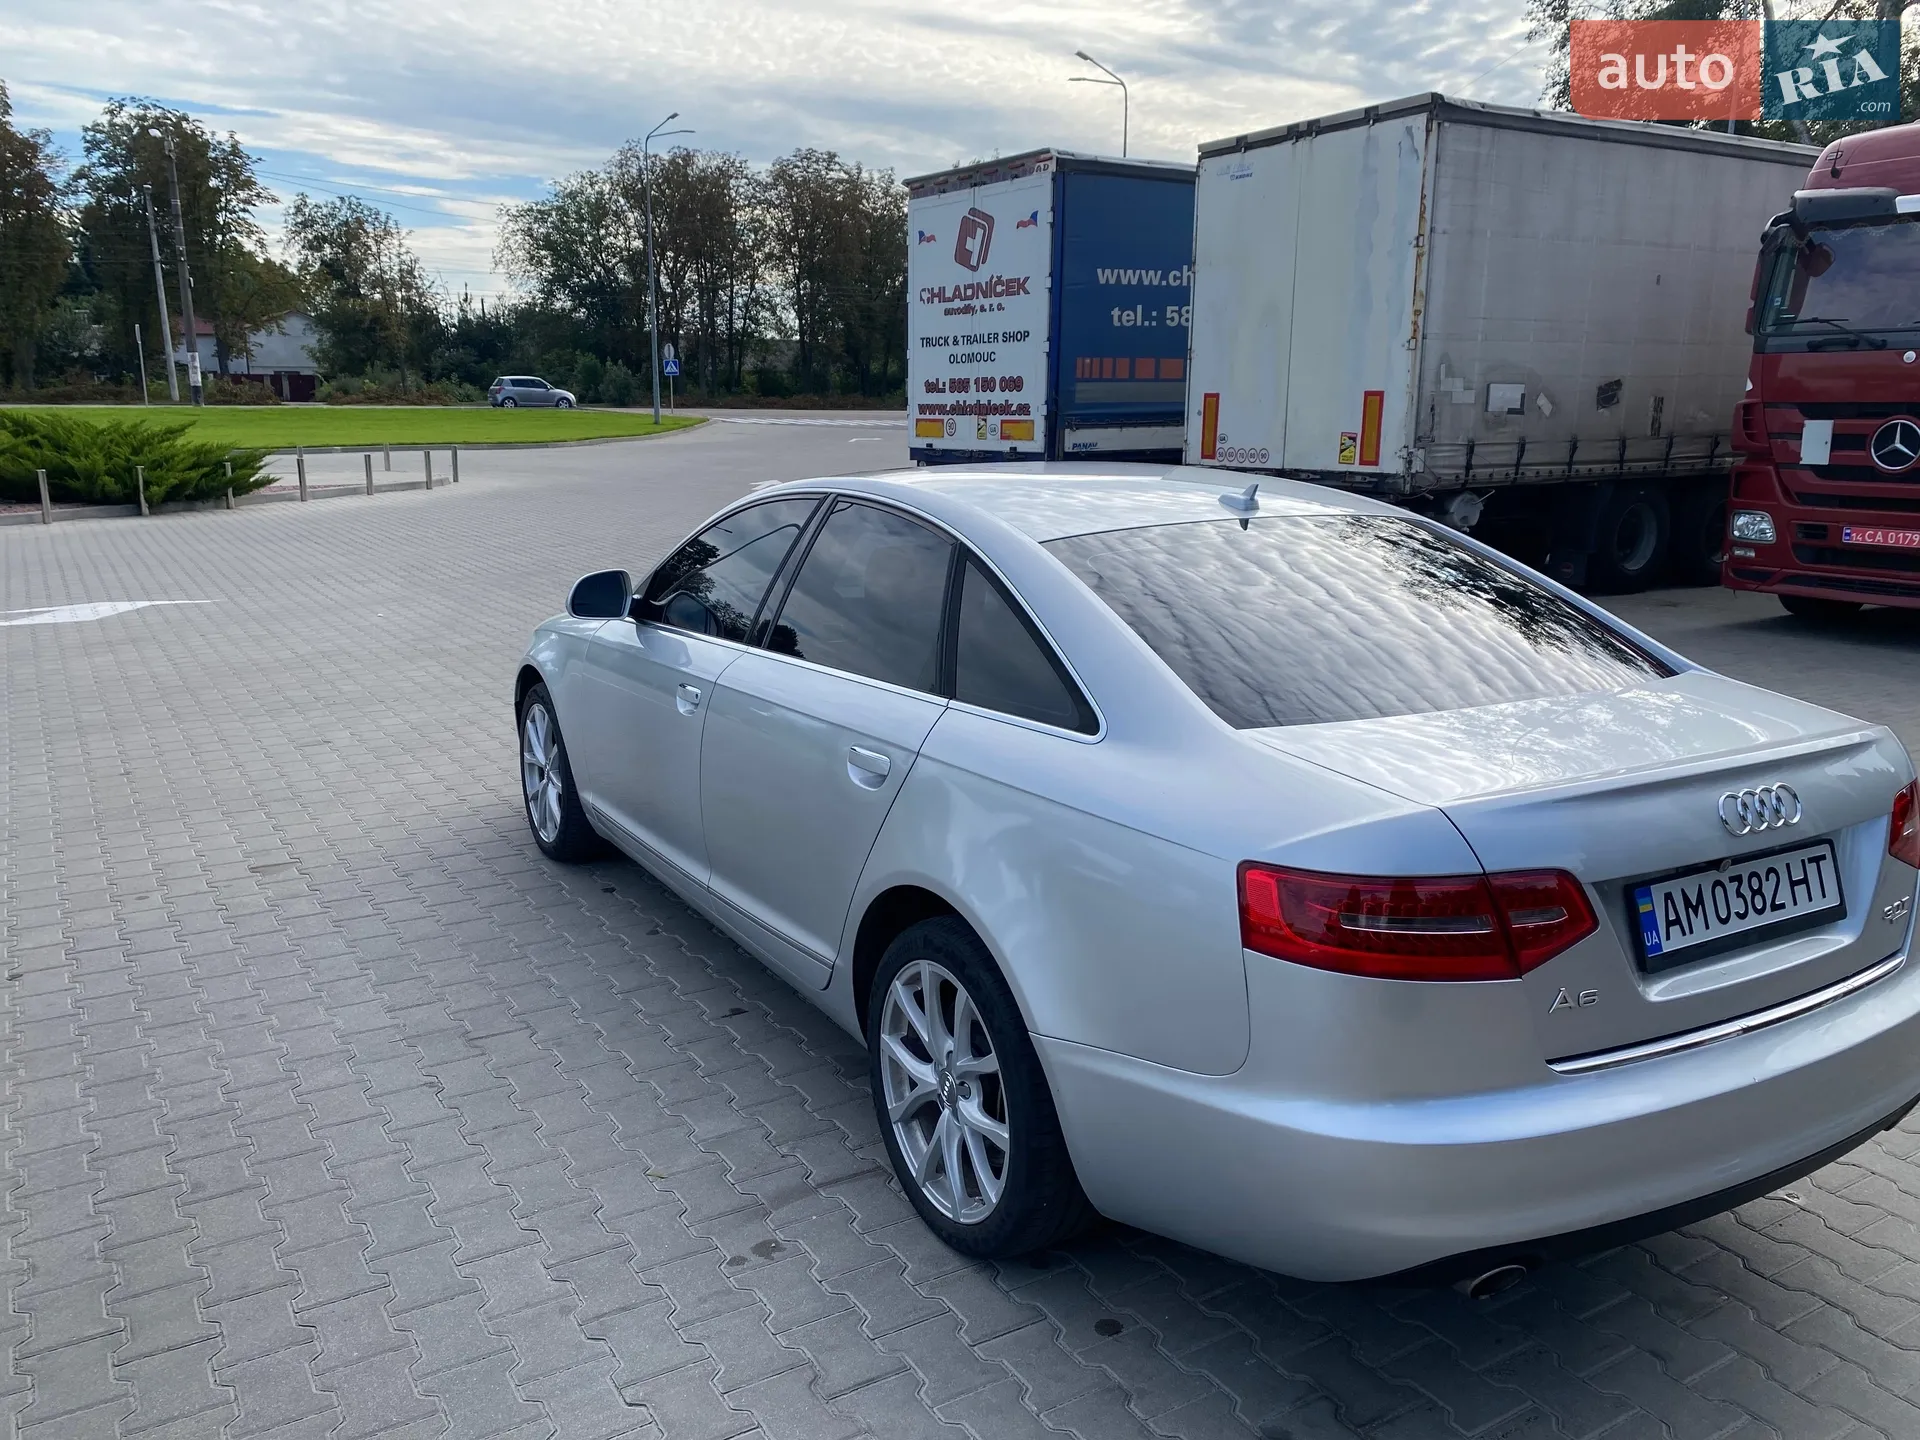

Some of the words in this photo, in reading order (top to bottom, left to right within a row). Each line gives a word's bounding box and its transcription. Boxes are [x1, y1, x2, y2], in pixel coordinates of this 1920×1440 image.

[920, 274, 1031, 304] CHLADNÍČEK
[1111, 304, 1157, 327] tel.:
[920, 336, 950, 348] TRUCK
[952, 335, 960, 346] &
[961, 332, 999, 346] TRAILER
[1002, 330, 1030, 343] SHOP
[949, 351, 996, 364] OLOMOUC
[949, 378, 971, 393] 585
[974, 376, 997, 393] 150
[999, 375, 1024, 392] 069
[1072, 442, 1098, 450] PANAV
[1865, 531, 1883, 543] CA
[1888, 532, 1920, 546] 0179
[1644, 932, 1660, 946] UA
[1548, 986, 1599, 1014] A6
